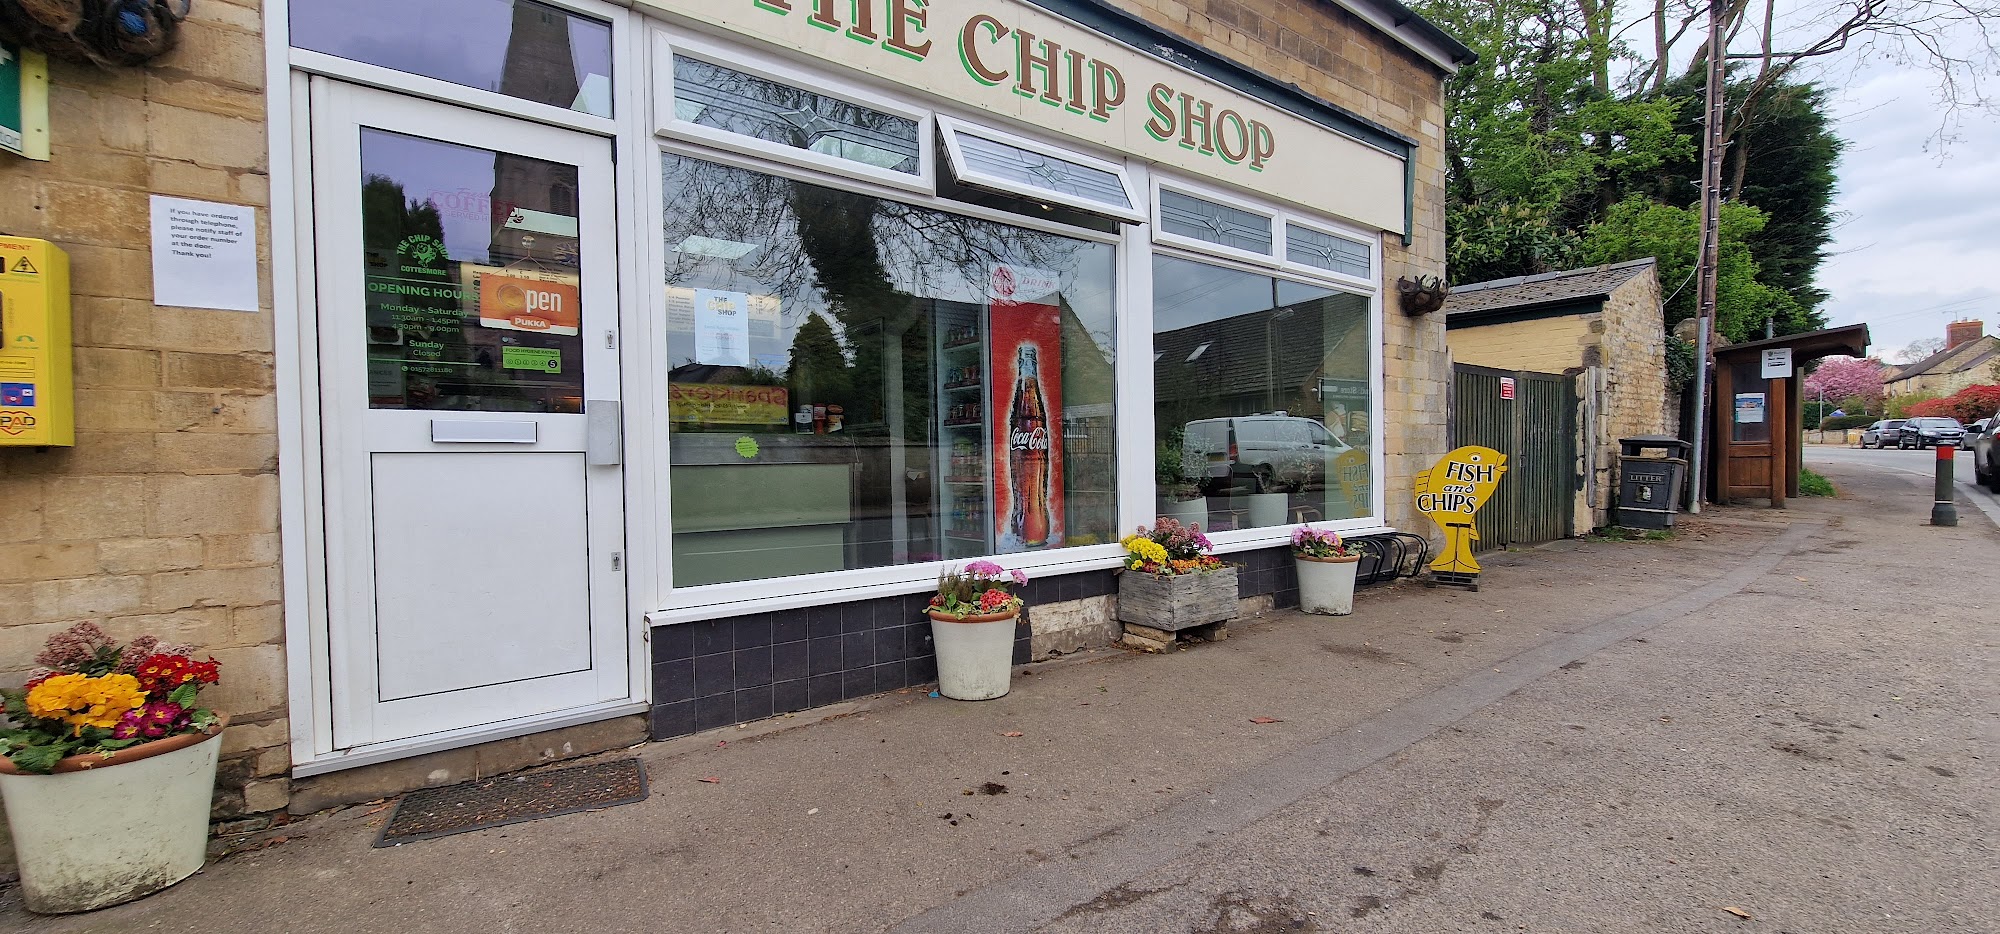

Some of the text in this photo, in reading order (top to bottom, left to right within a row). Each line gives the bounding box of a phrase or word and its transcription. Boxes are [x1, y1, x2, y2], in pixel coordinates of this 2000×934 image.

[753, 0, 1275, 172] HE CHIP SHOP
[170, 216, 238, 229] through telephone,
[211, 213, 239, 221] ordered
[195, 227, 216, 235] notify
[194, 242, 214, 250] door.
[397, 234, 451, 260] THE CHIP SHOP
[171, 249, 194, 257] Thank
[400, 265, 447, 276] COTTESMORE
[367, 282, 431, 297] OPENING
[433, 288, 480, 301] HOURS
[380, 303, 420, 314] Monday
[427, 306, 469, 318] Saturday
[718, 309, 737, 317] SHOP
[514, 317, 547, 328] PUKKA
[409, 339, 445, 350] Sunday
[413, 349, 441, 357] Closed
[1010, 426, 1048, 451] Coca-Cola
[1446, 460, 1494, 482] FISH
[1630, 474, 1662, 482] LITTER
[1443, 483, 1475, 494] and
[1416, 492, 1476, 514] CHIPS
